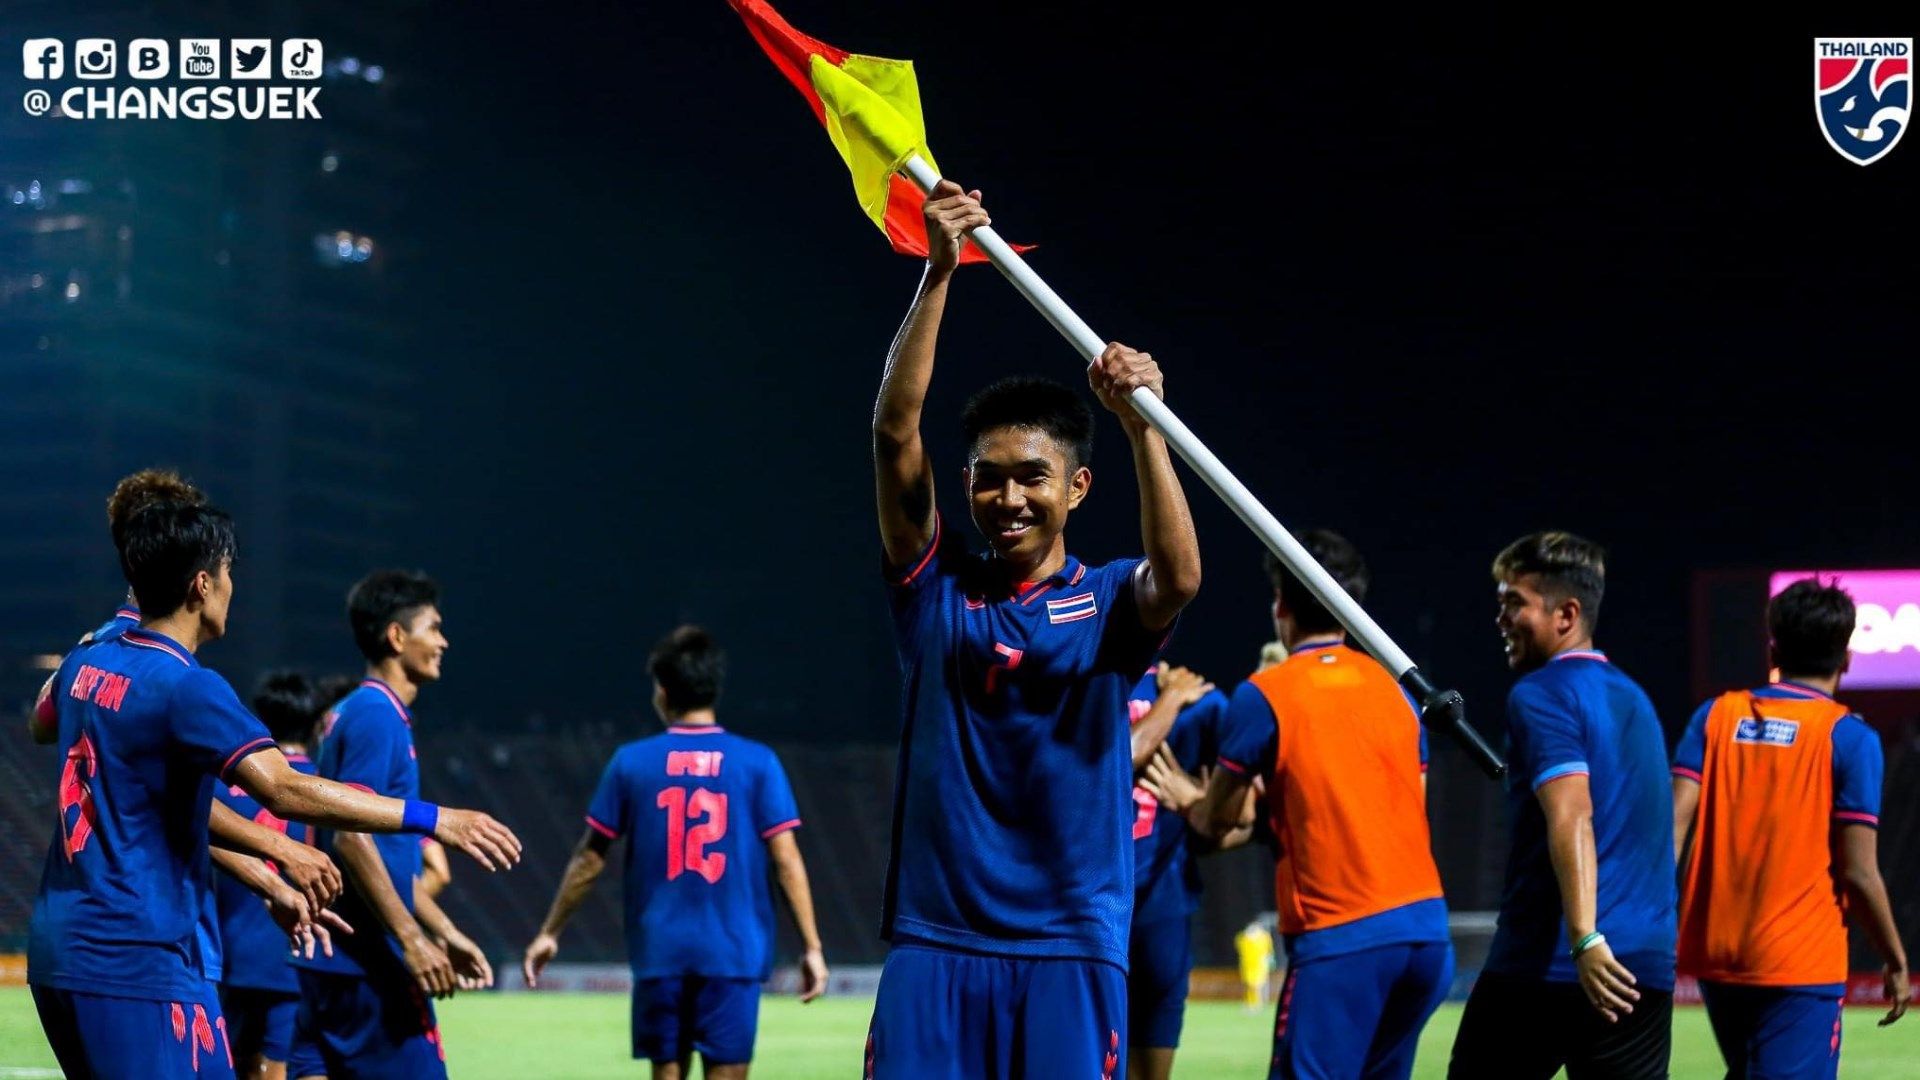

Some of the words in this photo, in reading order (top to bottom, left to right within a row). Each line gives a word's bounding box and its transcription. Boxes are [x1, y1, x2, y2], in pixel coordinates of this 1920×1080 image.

[987, 642, 1024, 694] 7
[58, 730, 97, 863] 6
[657, 786, 728, 883] 12
